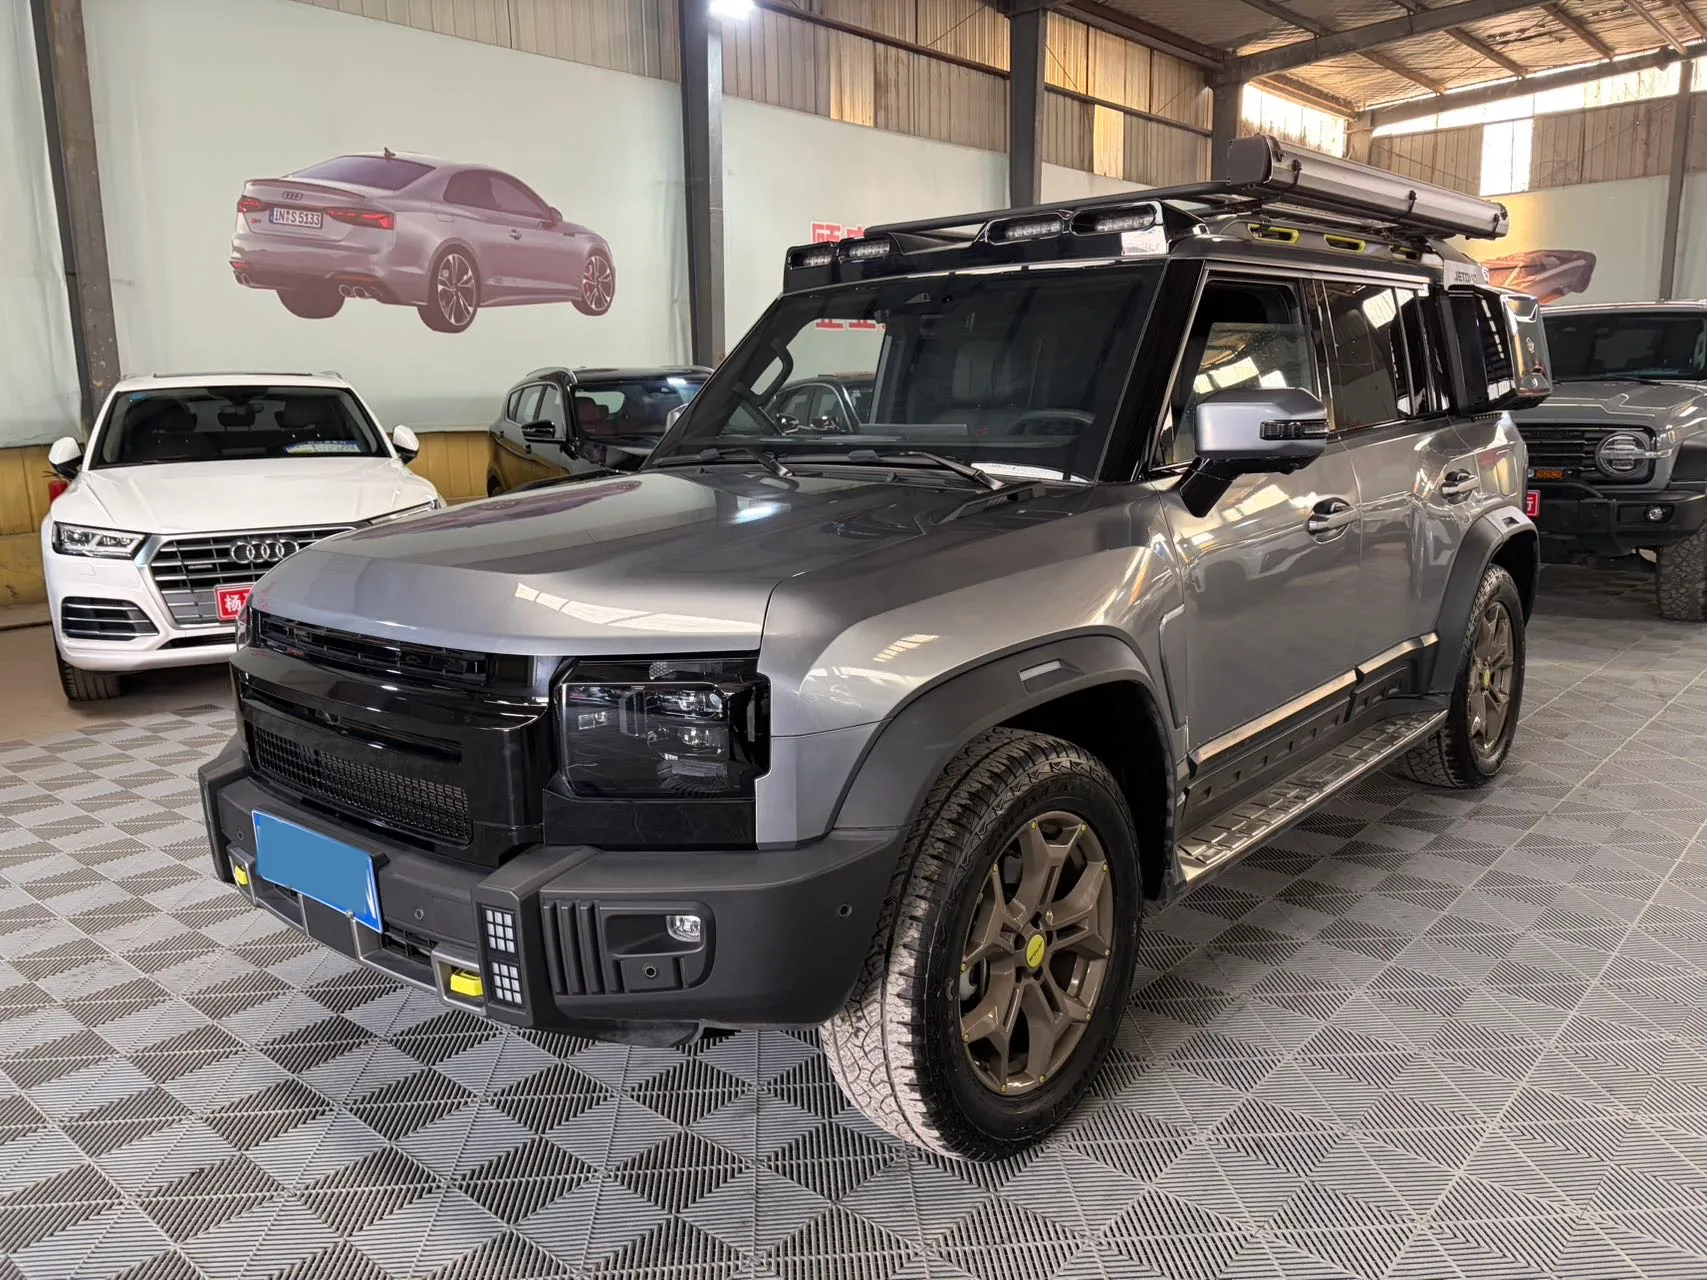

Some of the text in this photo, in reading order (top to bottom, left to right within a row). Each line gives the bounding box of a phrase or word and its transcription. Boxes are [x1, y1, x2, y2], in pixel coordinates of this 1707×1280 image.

[275, 209, 286, 221] IN
[291, 211, 297, 223] S
[298, 212, 321, 226] 5133
